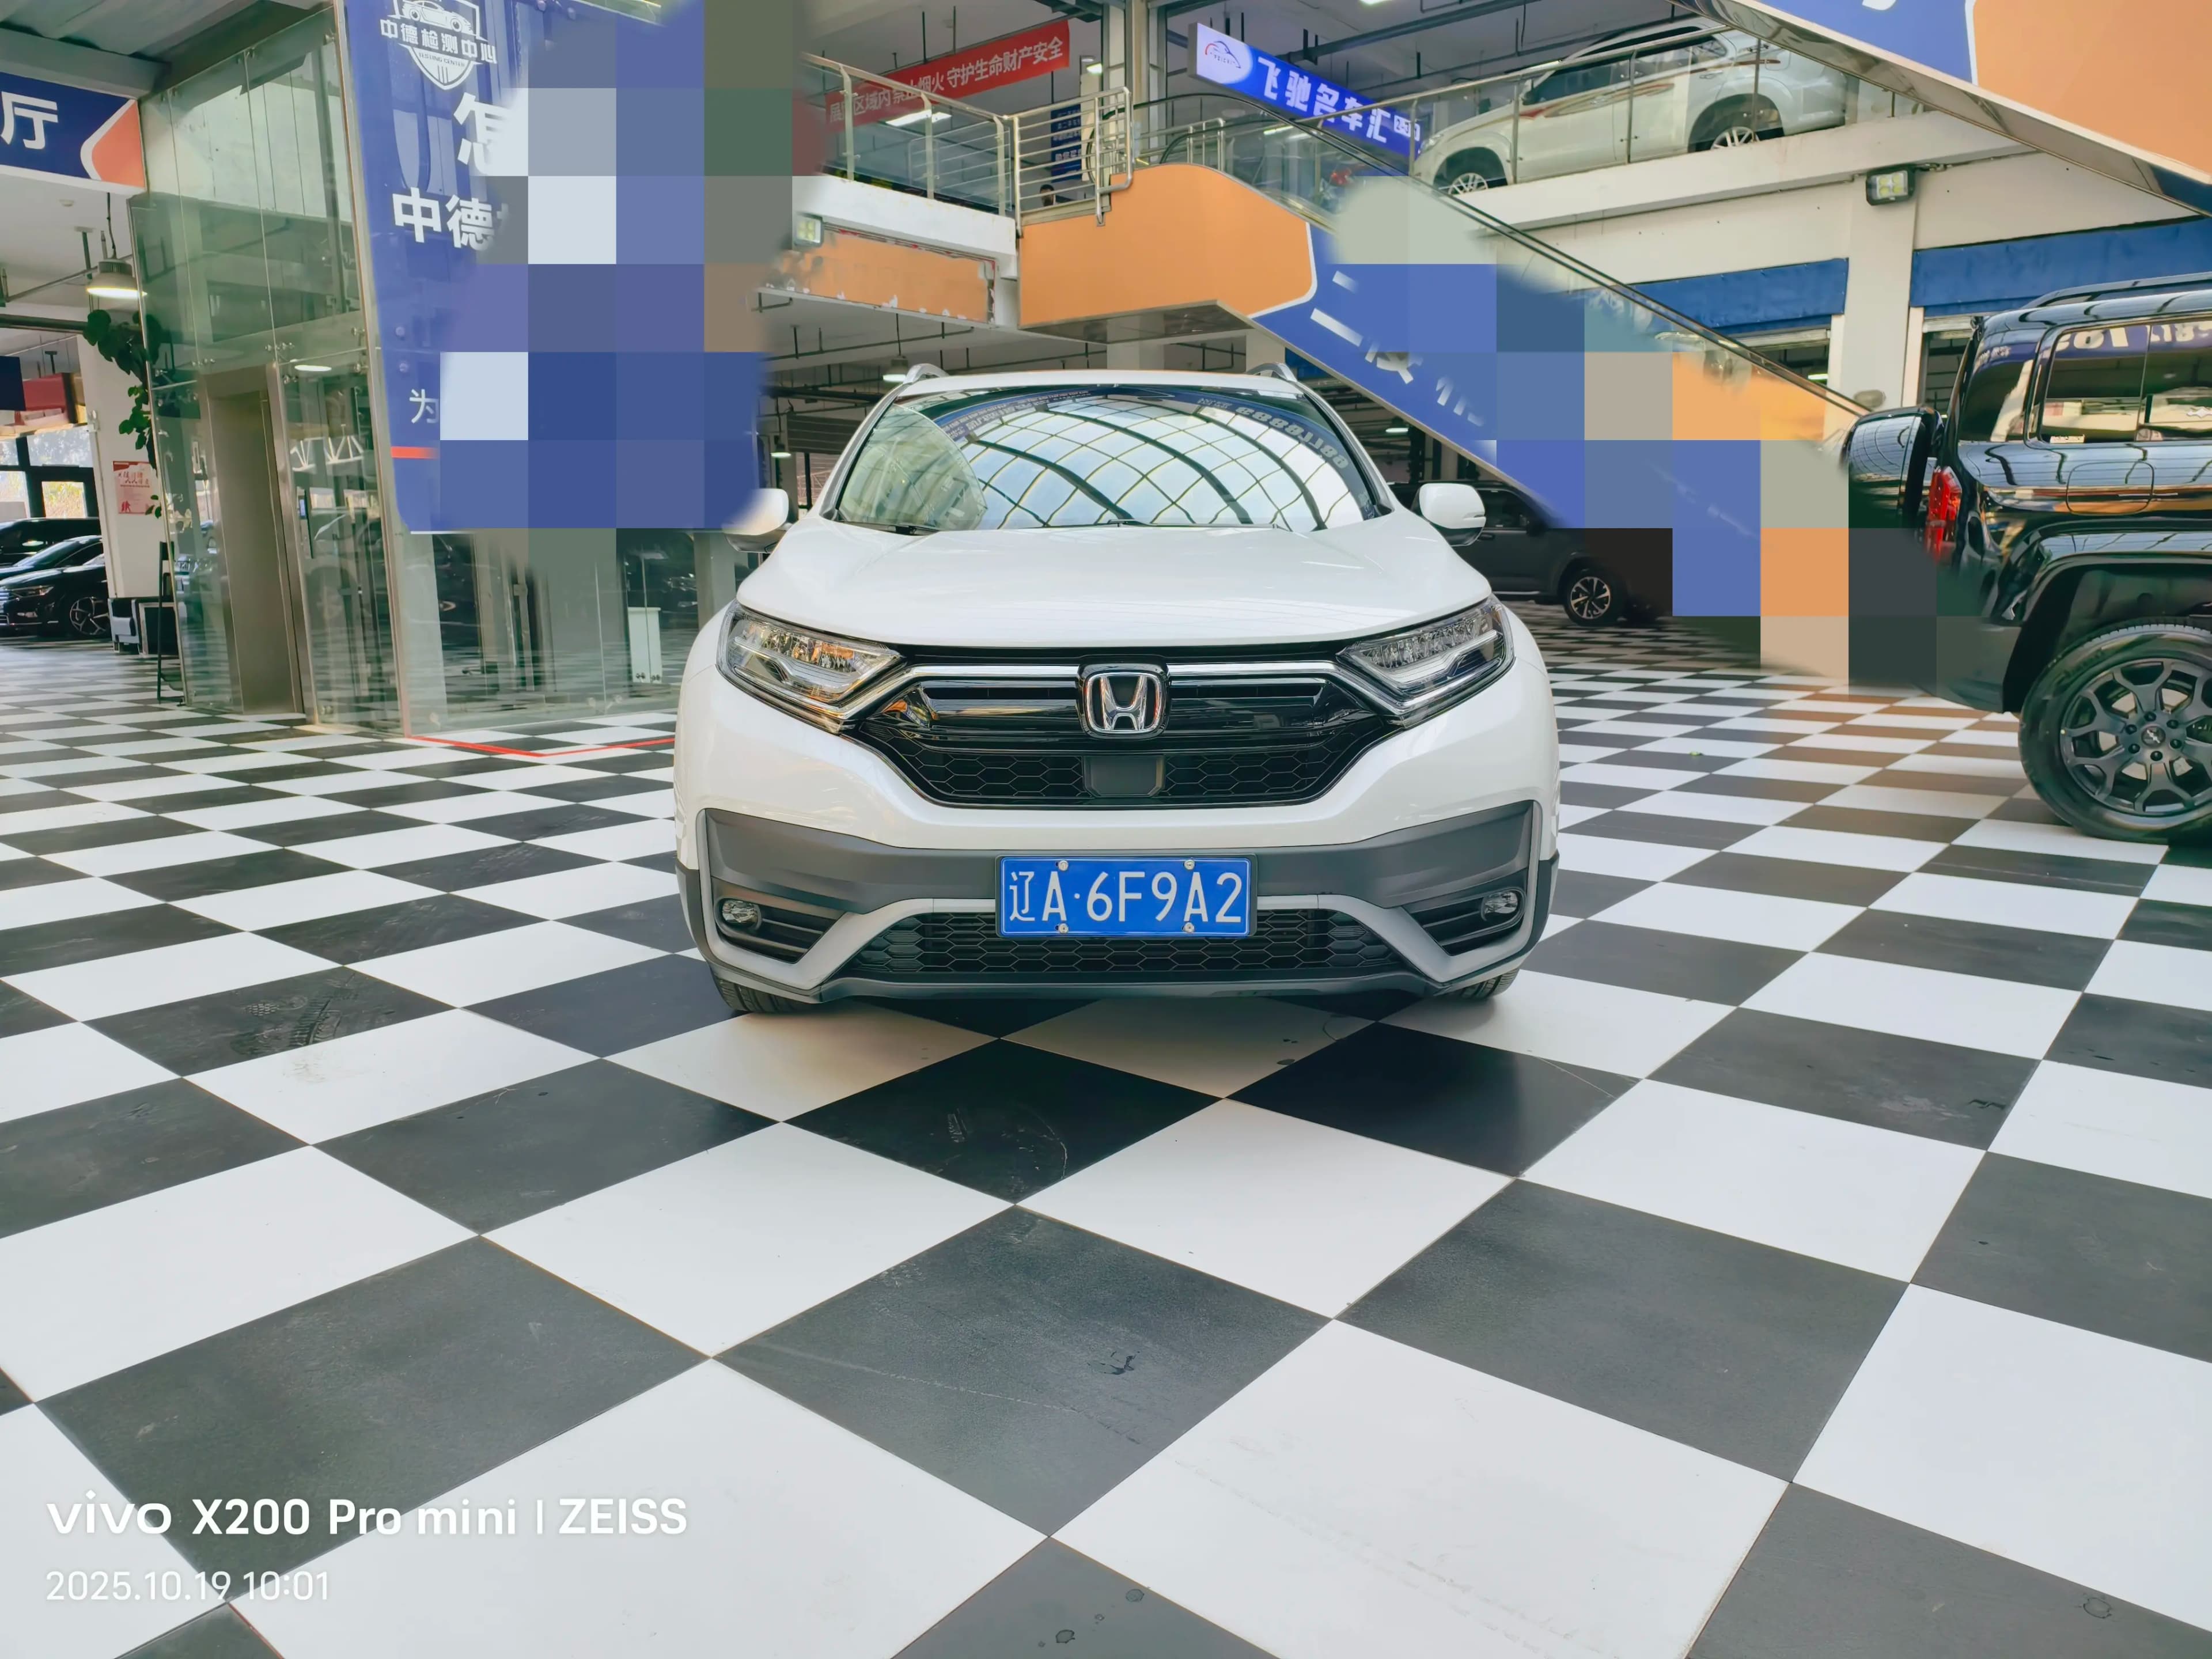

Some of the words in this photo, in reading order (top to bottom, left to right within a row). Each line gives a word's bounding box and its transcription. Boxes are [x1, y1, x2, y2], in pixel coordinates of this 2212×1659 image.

[380, 19, 497, 64] 中德检测中心
[946, 36, 1063, 89] 守护生命财产安全
[1, 91, 58, 150] 厅
[1257, 56, 1391, 143] 飞驰名车汇
[392, 187, 509, 251] 中德
[1009, 870, 1243, 923] 辽A·6F9A2
